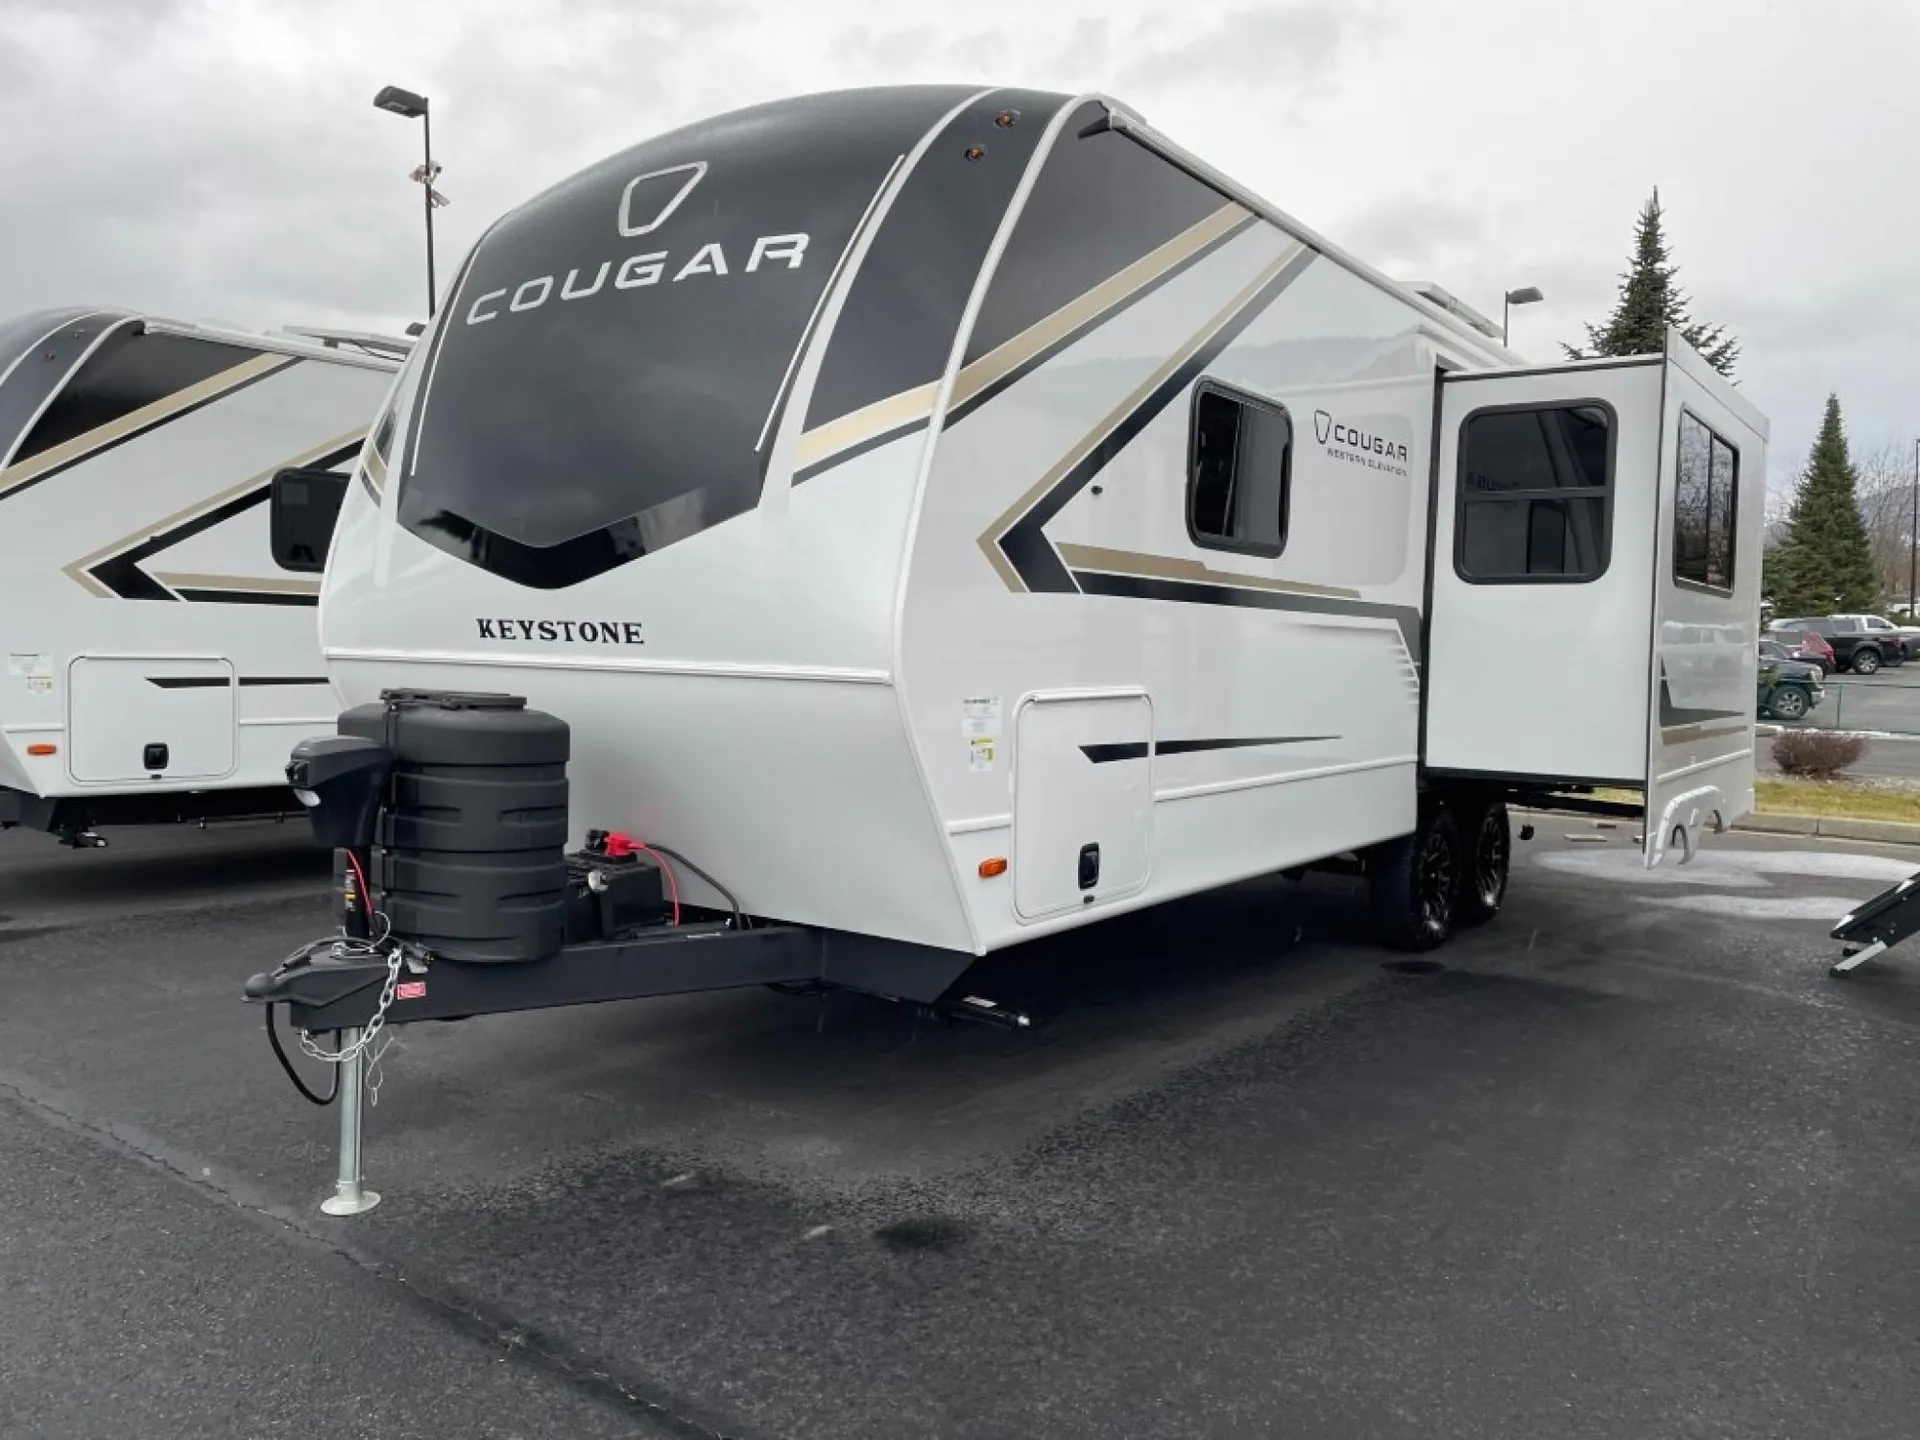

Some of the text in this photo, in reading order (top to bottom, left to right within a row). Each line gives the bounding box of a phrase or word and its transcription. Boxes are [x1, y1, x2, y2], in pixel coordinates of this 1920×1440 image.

[466, 233, 810, 325] COUGAR
[1327, 447, 1366, 466] WESTERN
[1334, 424, 1407, 463] COUGAR
[476, 618, 645, 644] KEYSTONE
